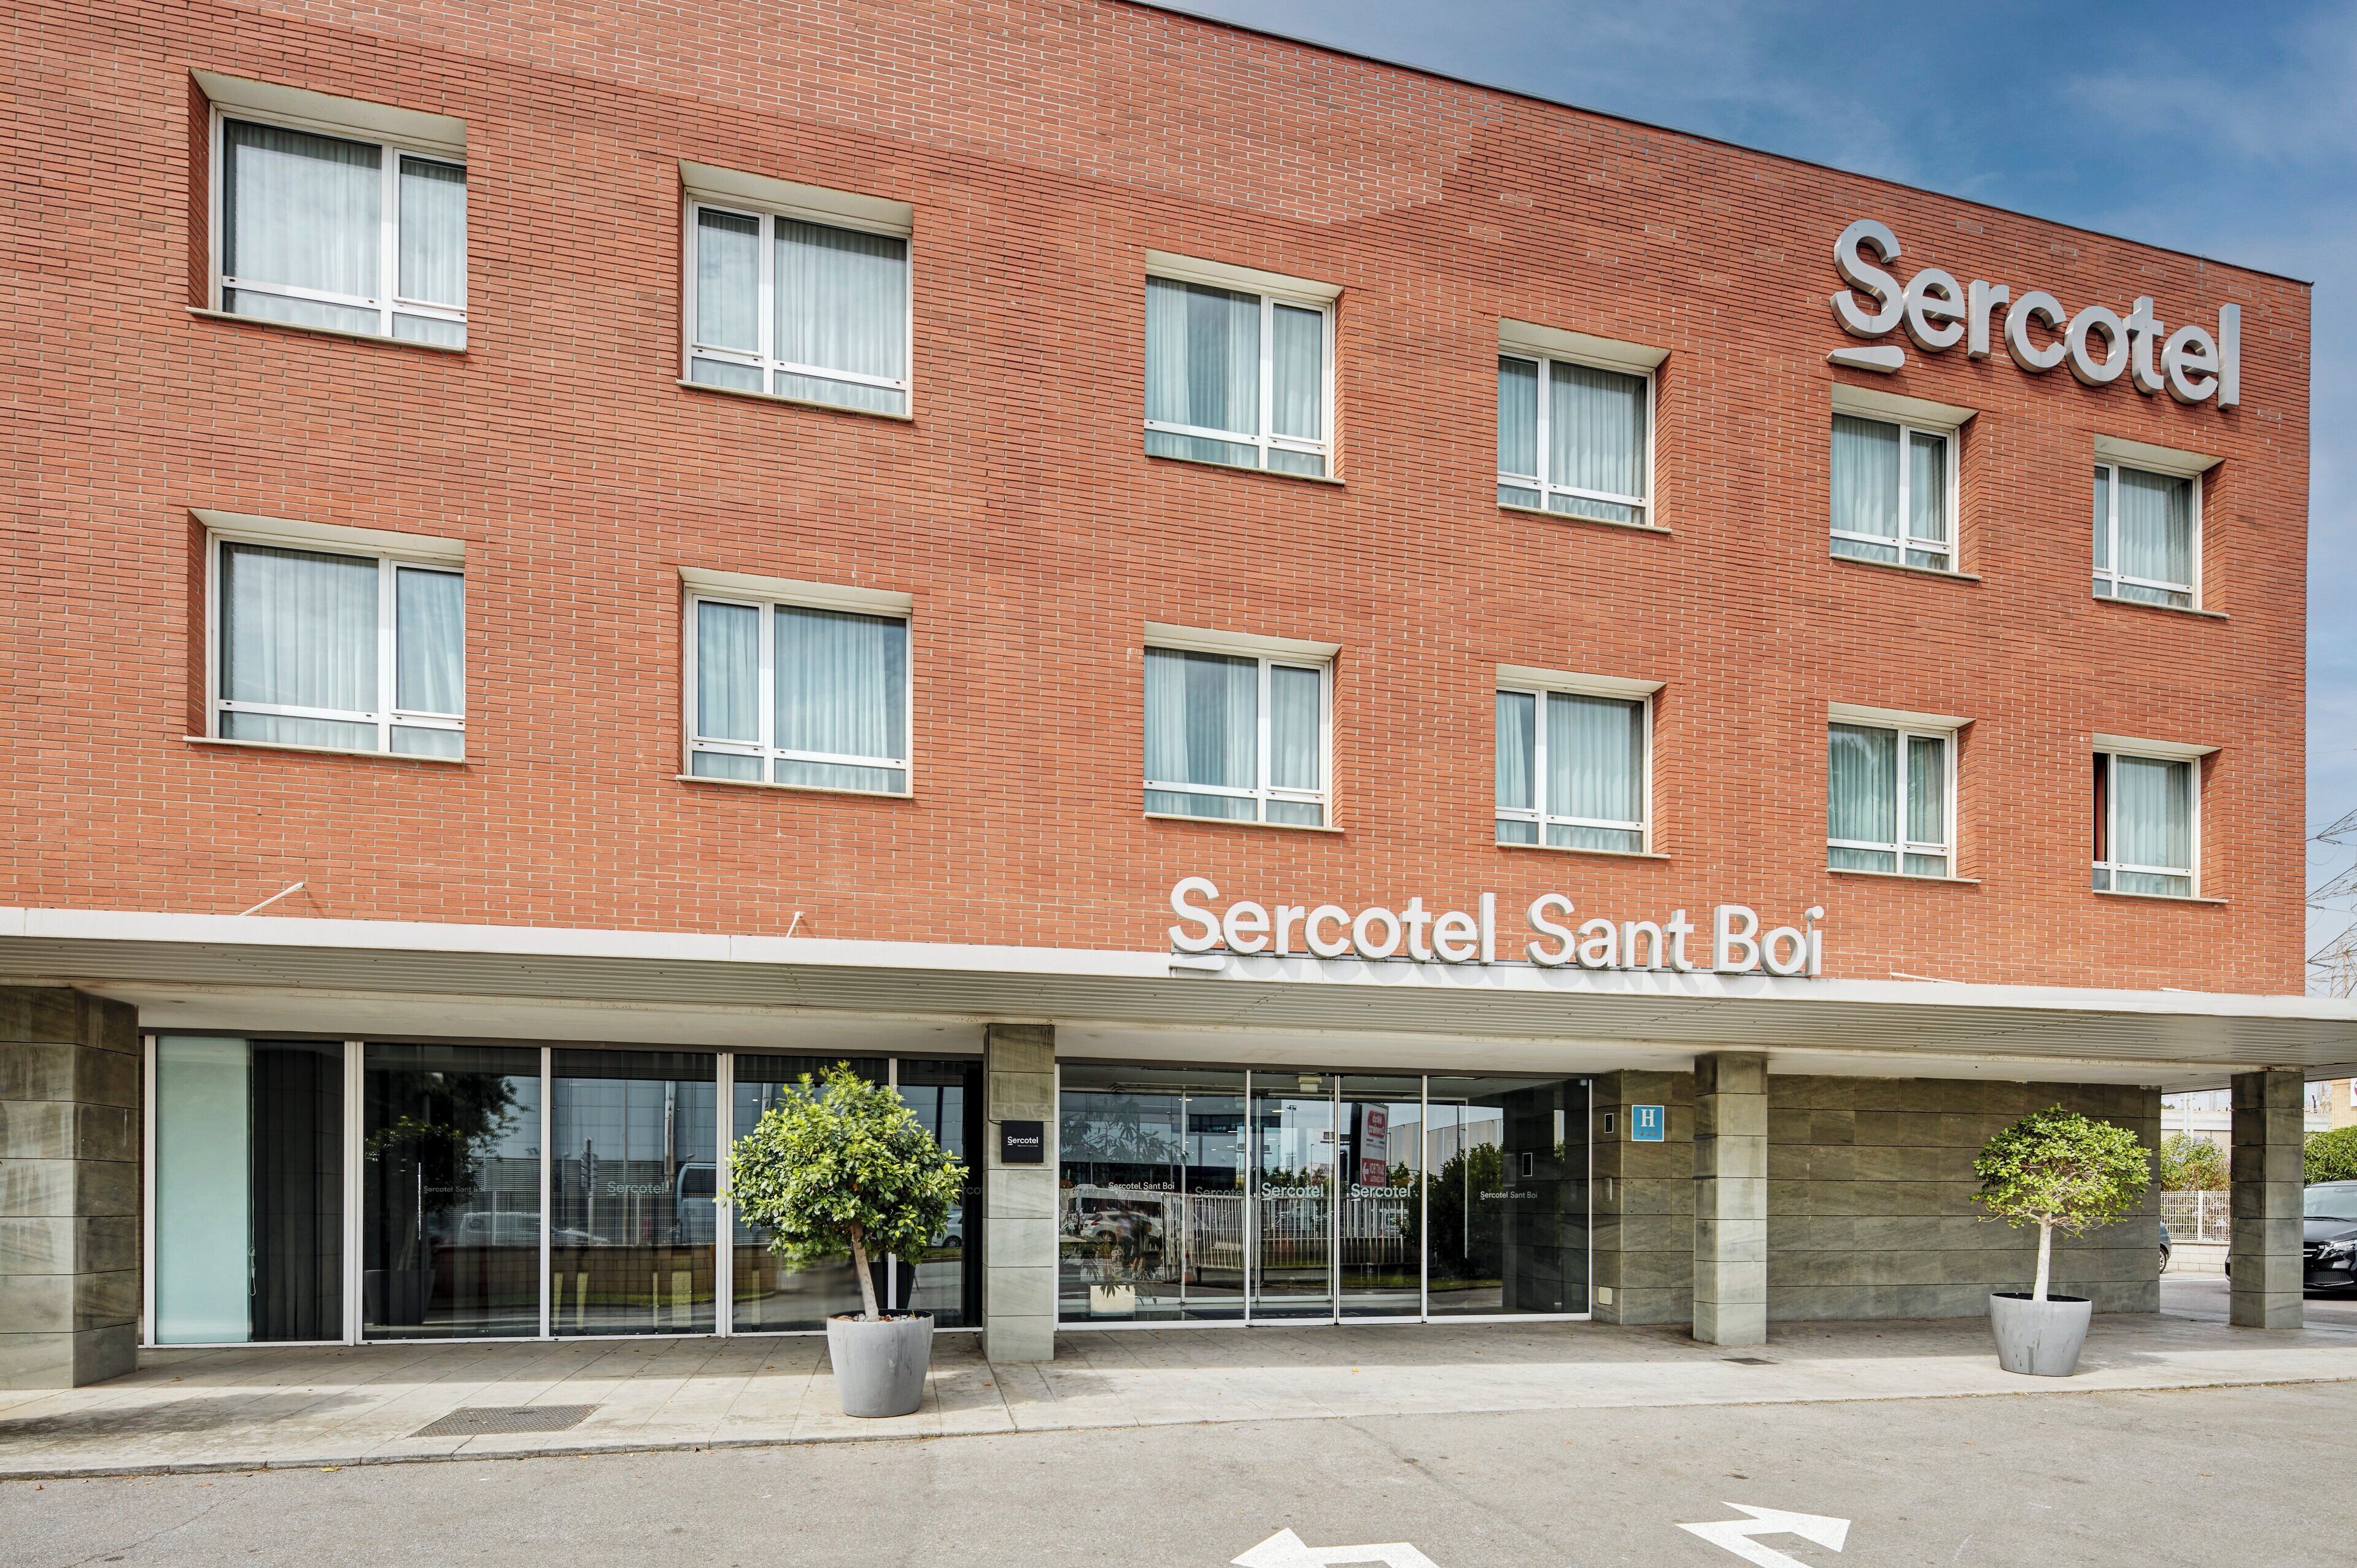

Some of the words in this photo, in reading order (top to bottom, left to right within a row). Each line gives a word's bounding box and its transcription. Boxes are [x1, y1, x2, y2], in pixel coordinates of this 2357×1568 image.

[1827, 219, 2241, 409] Sercotel
[1168, 876, 1495, 971] Sercotel
[1525, 894, 1694, 972] Sant
[1713, 905, 1824, 977] Boi
[1641, 1109, 1655, 1127] H
[1007, 1136, 1039, 1146] Sercotel
[606, 1181, 664, 1195] Sercotel
[1108, 1182, 1142, 1191] Sercotel
[1194, 1186, 1243, 1198] Sercote
[1261, 1182, 1324, 1200] Sercotel
[1350, 1183, 1411, 1201] Sercotel
[1480, 1191, 1508, 1200] Sercotel
